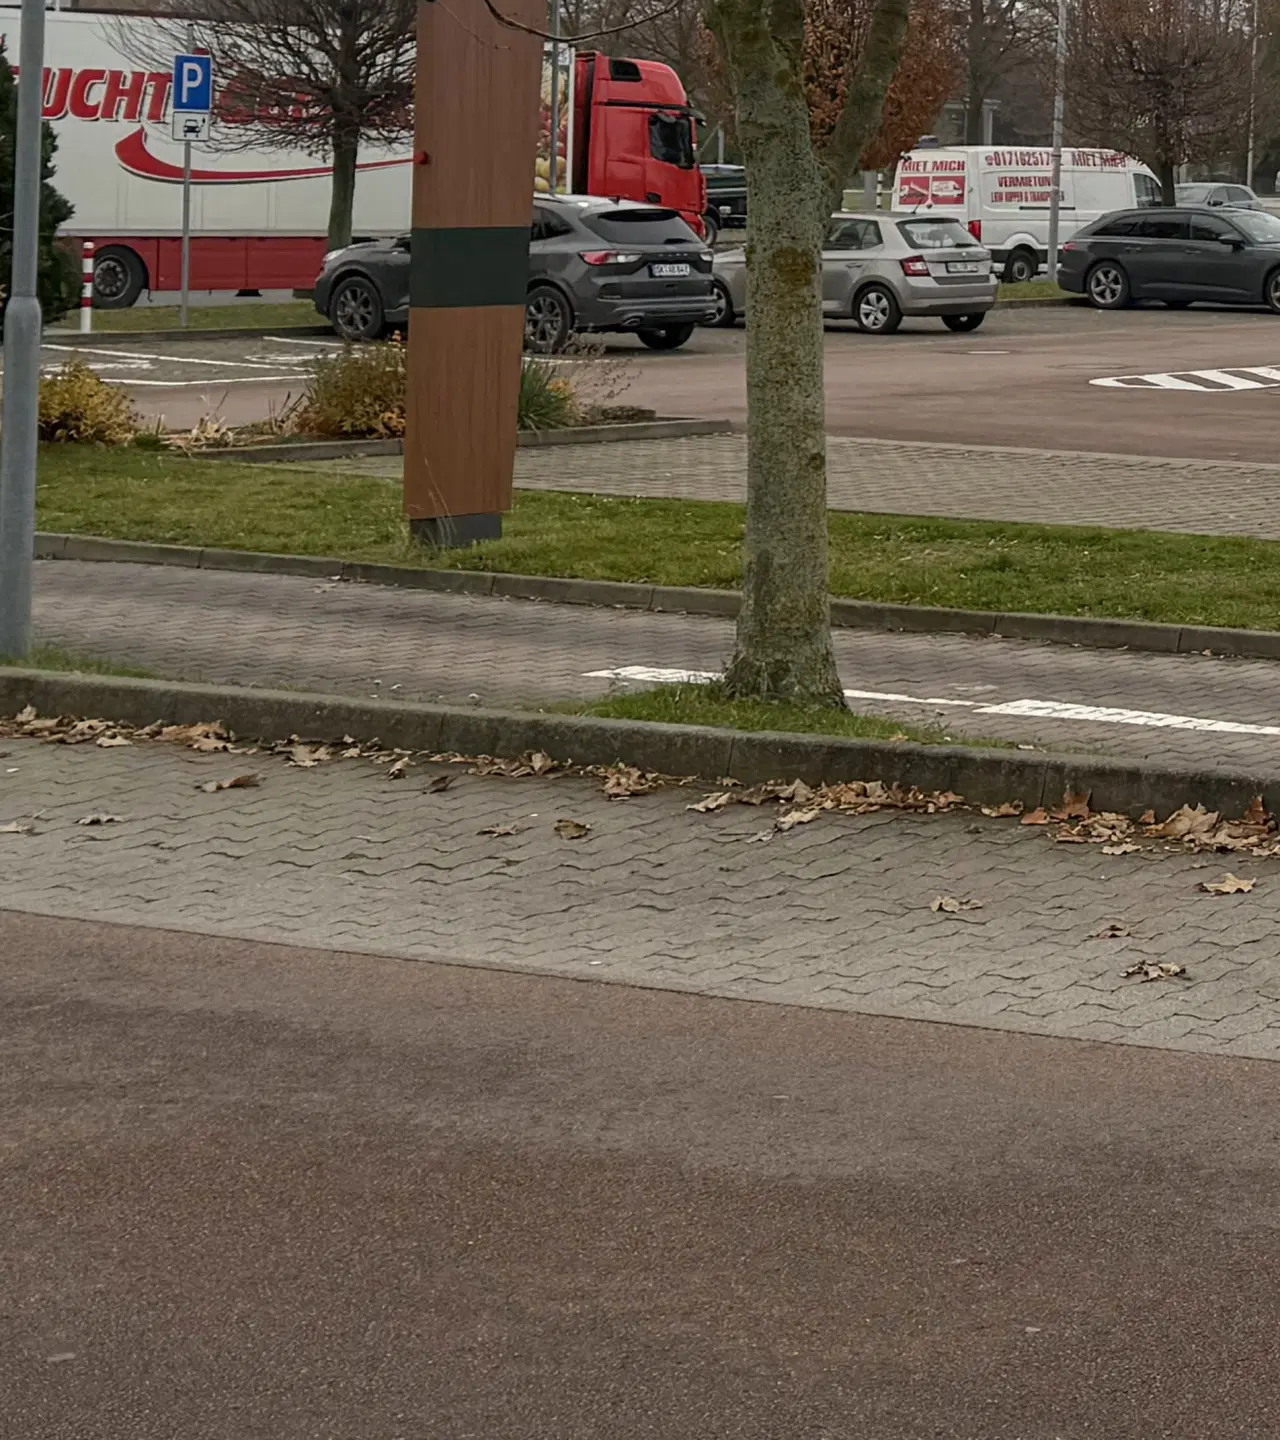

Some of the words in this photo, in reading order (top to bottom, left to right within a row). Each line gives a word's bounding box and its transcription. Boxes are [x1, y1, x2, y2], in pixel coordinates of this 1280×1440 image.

[11, 65, 174, 123] UCHT
[181, 62, 204, 104] P
[998, 175, 1052, 188] VERMIETUN
